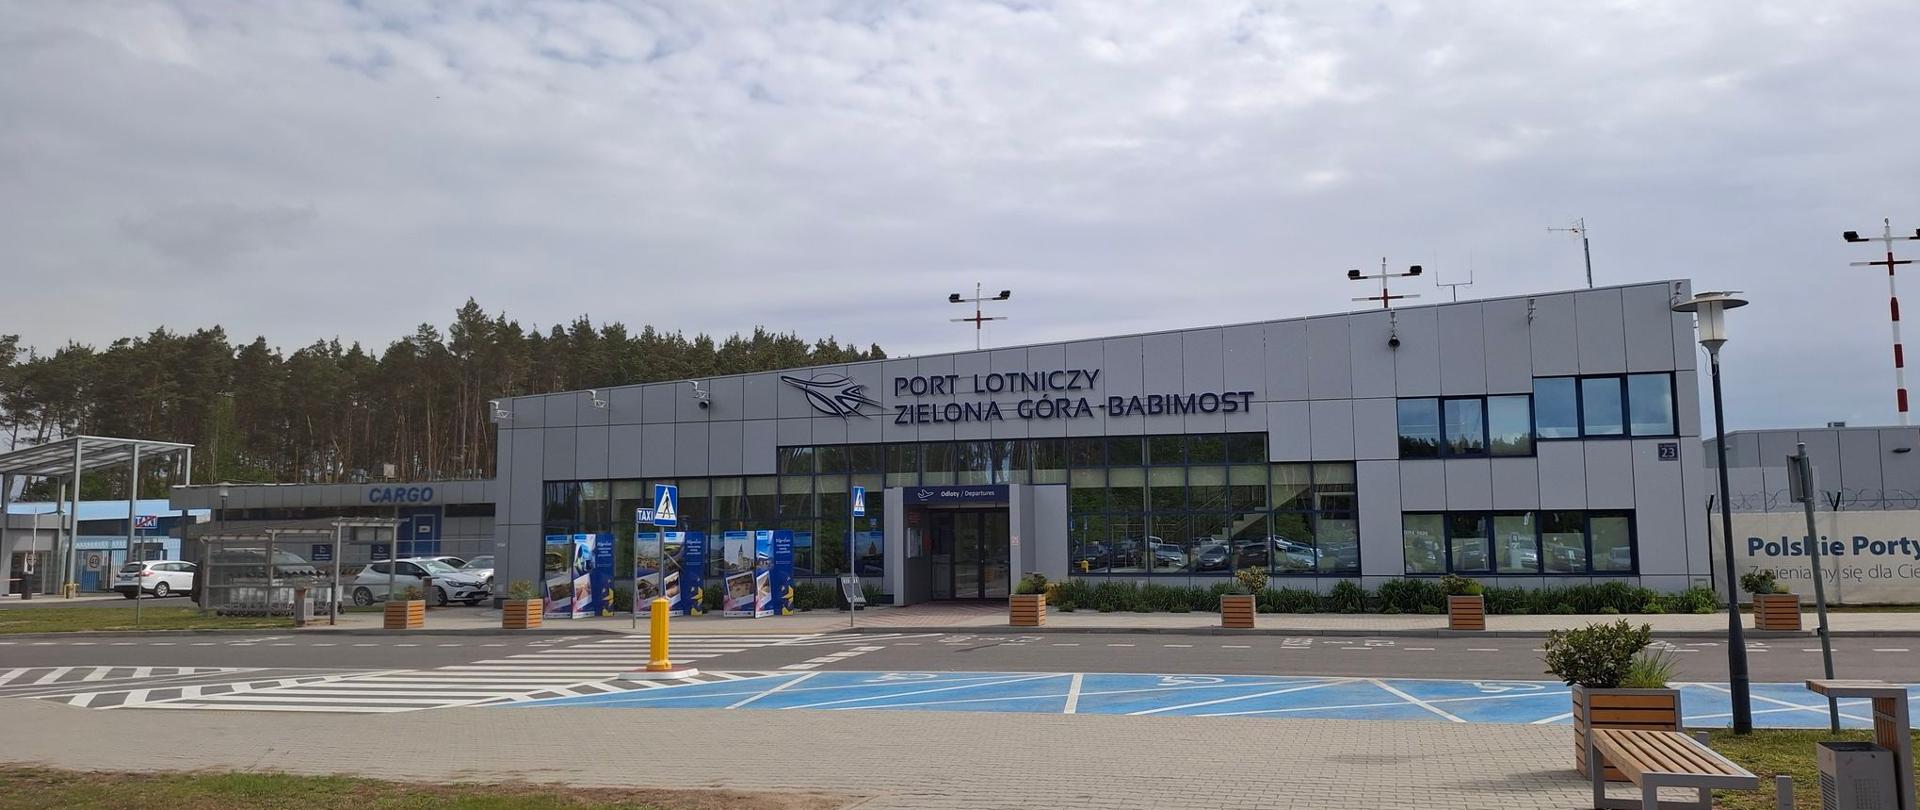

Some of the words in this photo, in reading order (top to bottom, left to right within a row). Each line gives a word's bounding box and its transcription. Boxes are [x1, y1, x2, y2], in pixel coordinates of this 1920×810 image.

[894, 374, 959, 396] PORT
[974, 368, 1101, 394] LOTNICZY
[894, 401, 1004, 425] ZIELONA
[1661, 447, 1675, 458] 23
[368, 486, 434, 502] CARGO
[964, 490, 996, 498] Departures
[135, 516, 156, 527] TAXI
[637, 510, 654, 521] TAXI
[1852, 536, 1920, 560] Porty
[1842, 565, 1863, 582] się
[1868, 563, 1893, 579] dla
